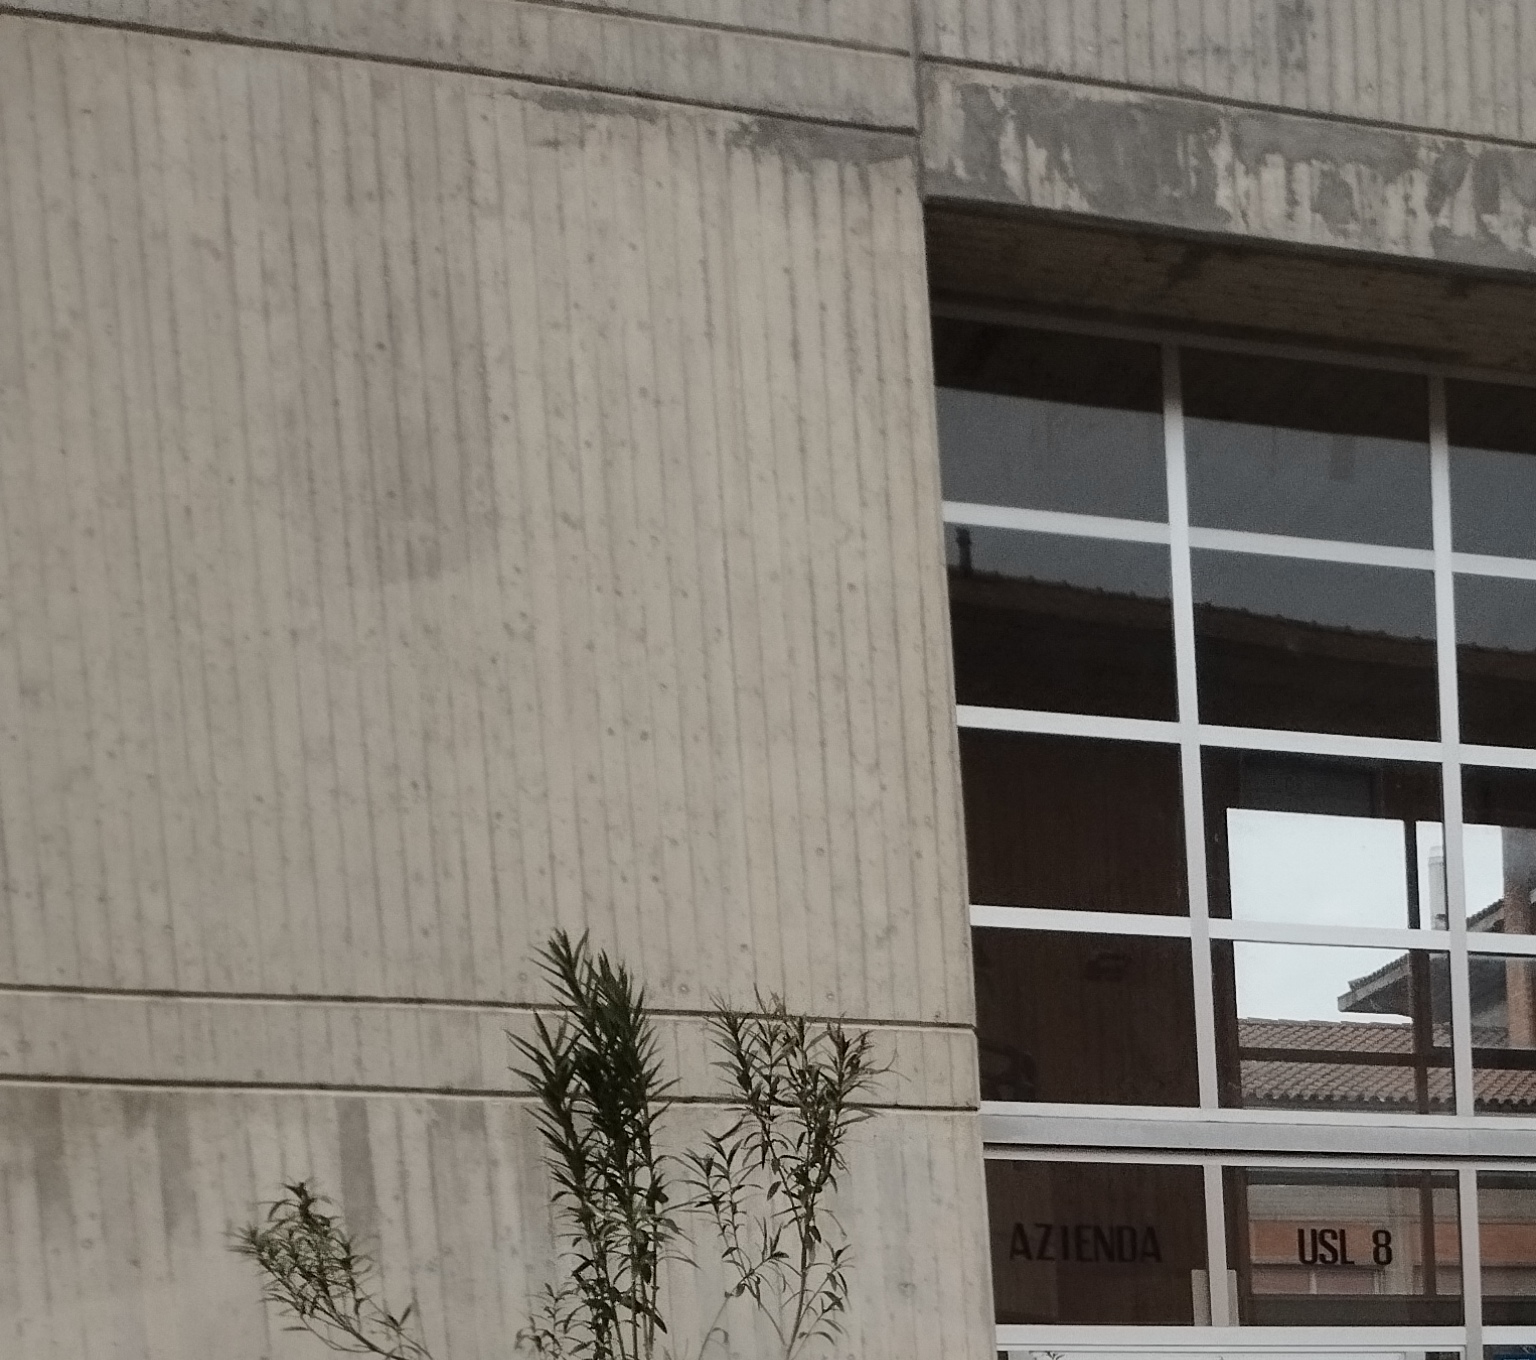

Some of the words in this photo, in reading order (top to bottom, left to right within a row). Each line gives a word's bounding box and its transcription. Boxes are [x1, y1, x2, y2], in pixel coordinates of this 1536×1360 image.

[1009, 1222, 1163, 1263] AZIENDA
[1297, 1228, 1355, 1265] USL
[1372, 1229, 1393, 1265] 8
